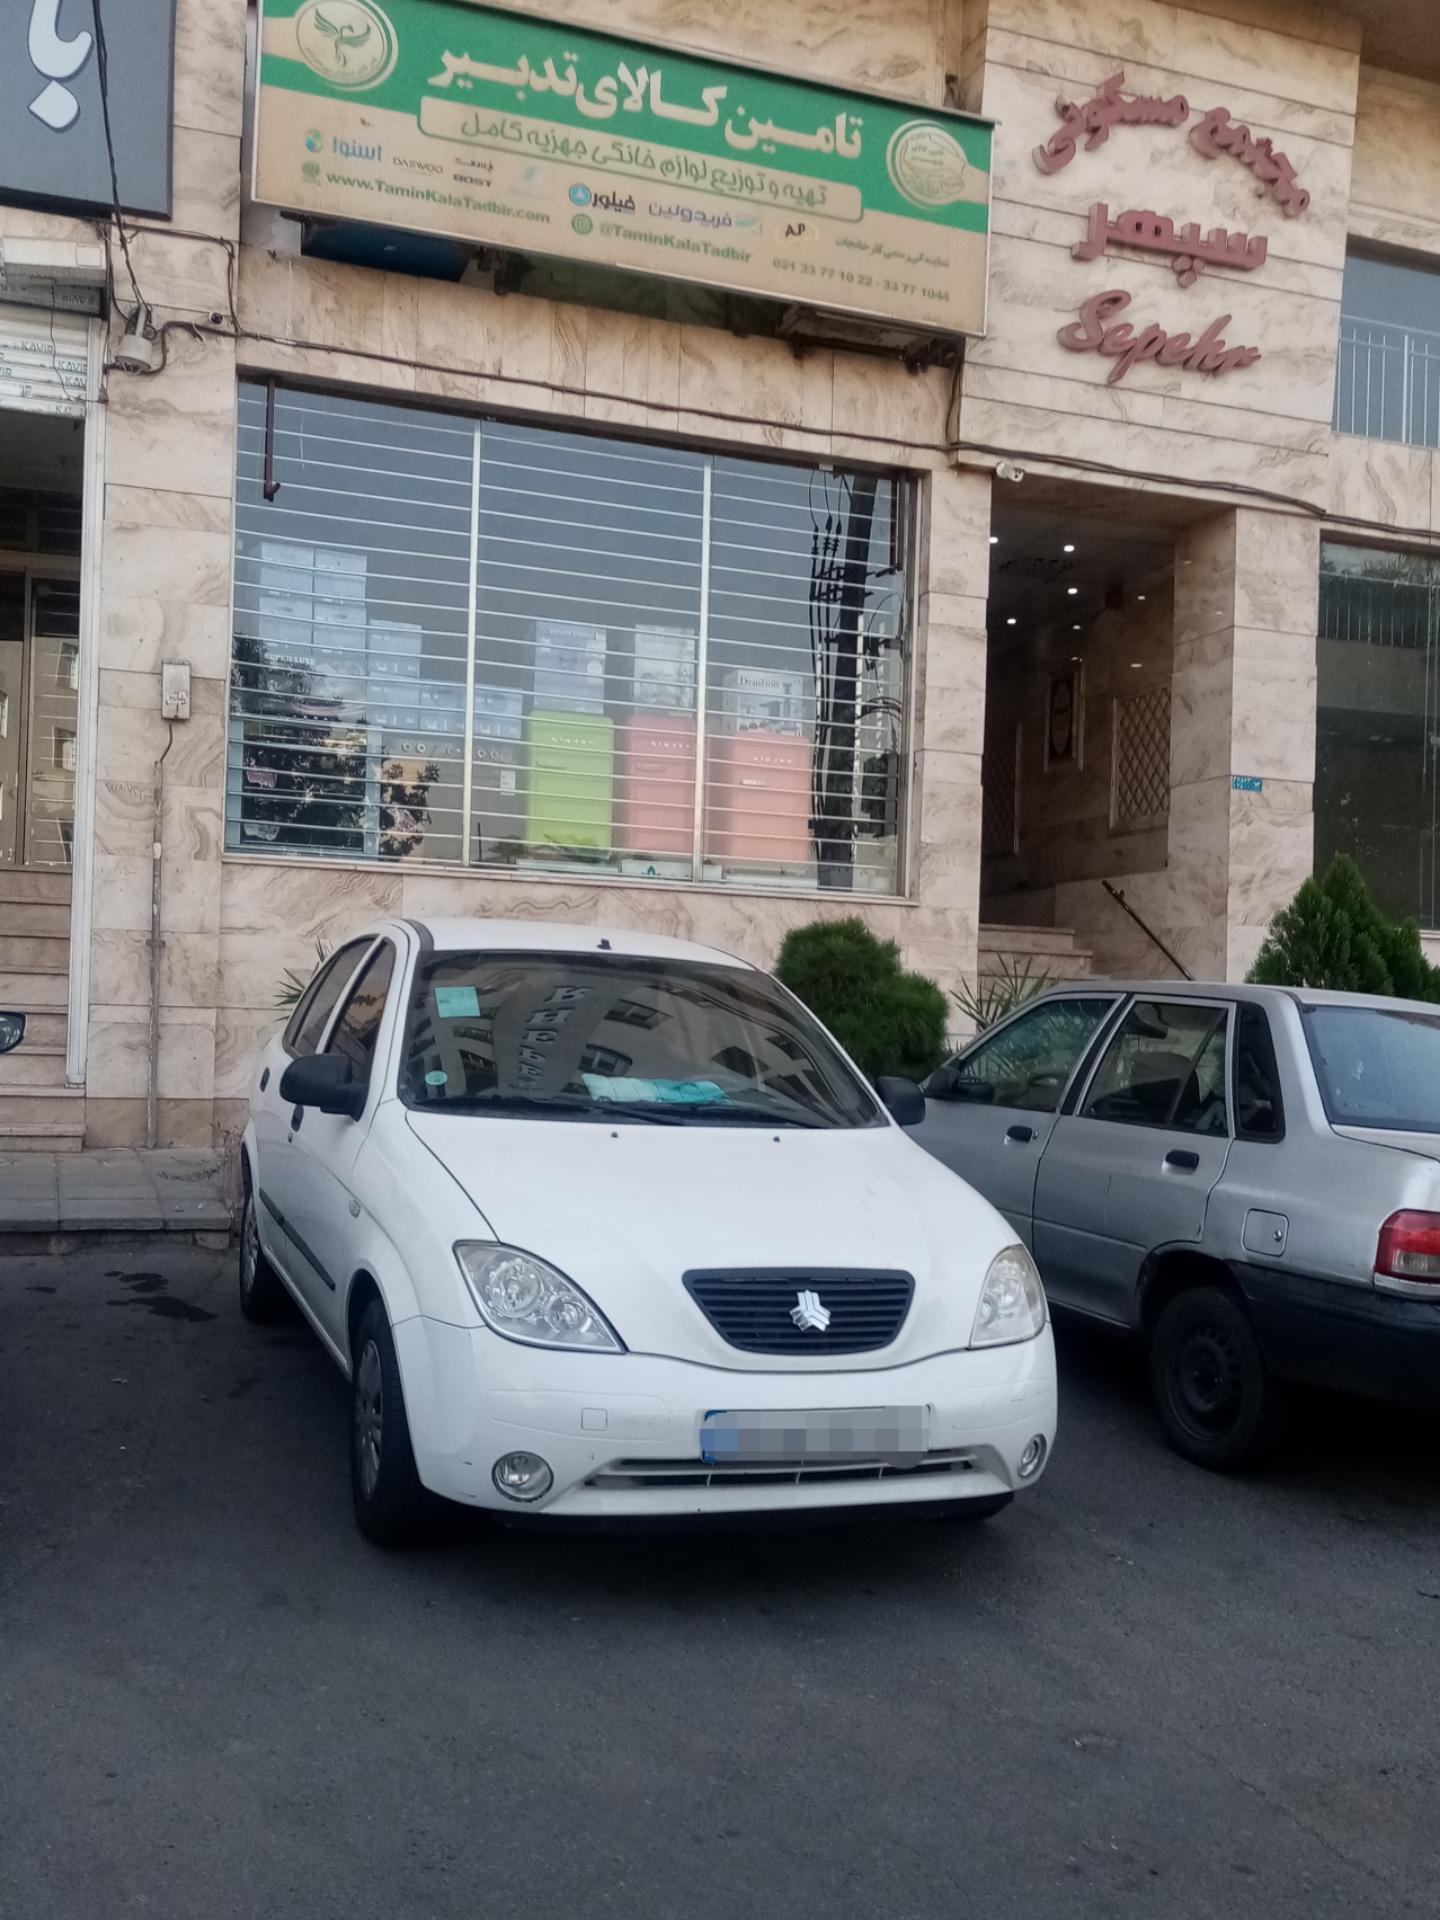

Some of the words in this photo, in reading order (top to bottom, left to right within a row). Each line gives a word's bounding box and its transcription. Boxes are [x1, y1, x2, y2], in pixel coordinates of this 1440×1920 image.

[427, 48, 579, 101] تدبیر
[576, 61, 728, 127] کالای
[461, 112, 523, 142] کامل
[724, 106, 863, 159] تامین
[1032, 70, 1190, 176] مسکونی
[332, 136, 382, 162] اسنوا
[392, 157, 443, 174] DAEWOO
[592, 140, 656, 170] خانگی
[660, 155, 707, 183] لوازم
[1189, 106, 1311, 218] مجتمع
[326, 173, 550, 224] www.TaminKalaTadbir.com
[711, 167, 766, 193] توزیع
[768, 180, 779, 199] و
[783, 183, 828, 207] تهیه
[600, 221, 752, 263] @TaminKalaTadbir
[1070, 202, 1268, 288] سپهر
[1056, 289, 1262, 385] Sepehr
